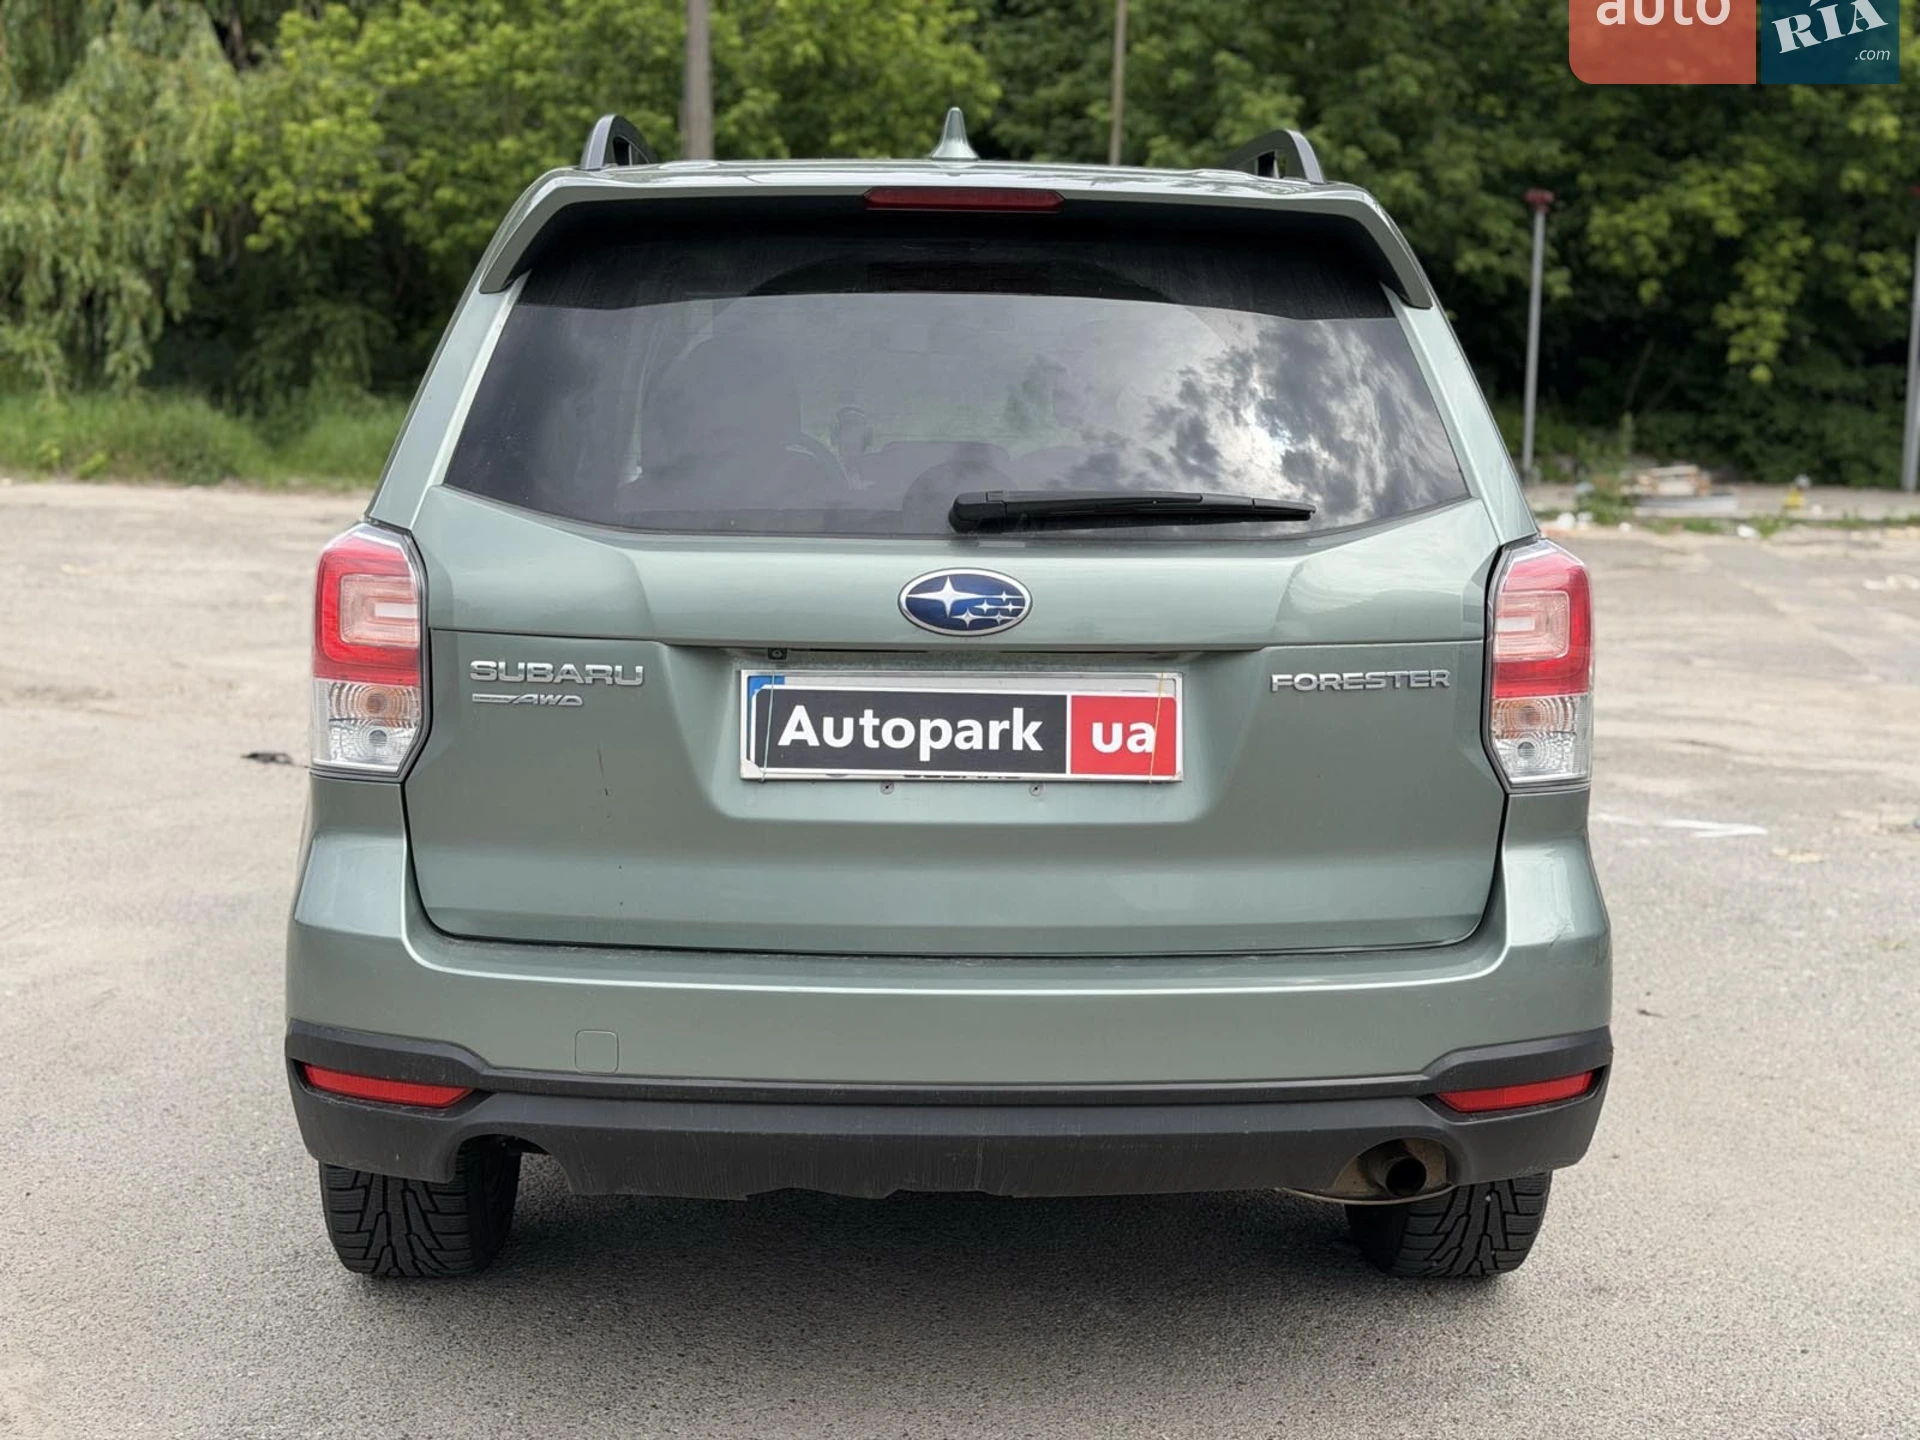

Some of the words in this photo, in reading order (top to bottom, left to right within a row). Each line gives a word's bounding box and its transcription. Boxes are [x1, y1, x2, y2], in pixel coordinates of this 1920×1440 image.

[470, 660, 644, 686] SUBARU
[1271, 669, 1451, 692] FORESTER
[512, 693, 583, 706] AWD
[777, 705, 1043, 762] Autopark
[1091, 720, 1154, 753] ua
